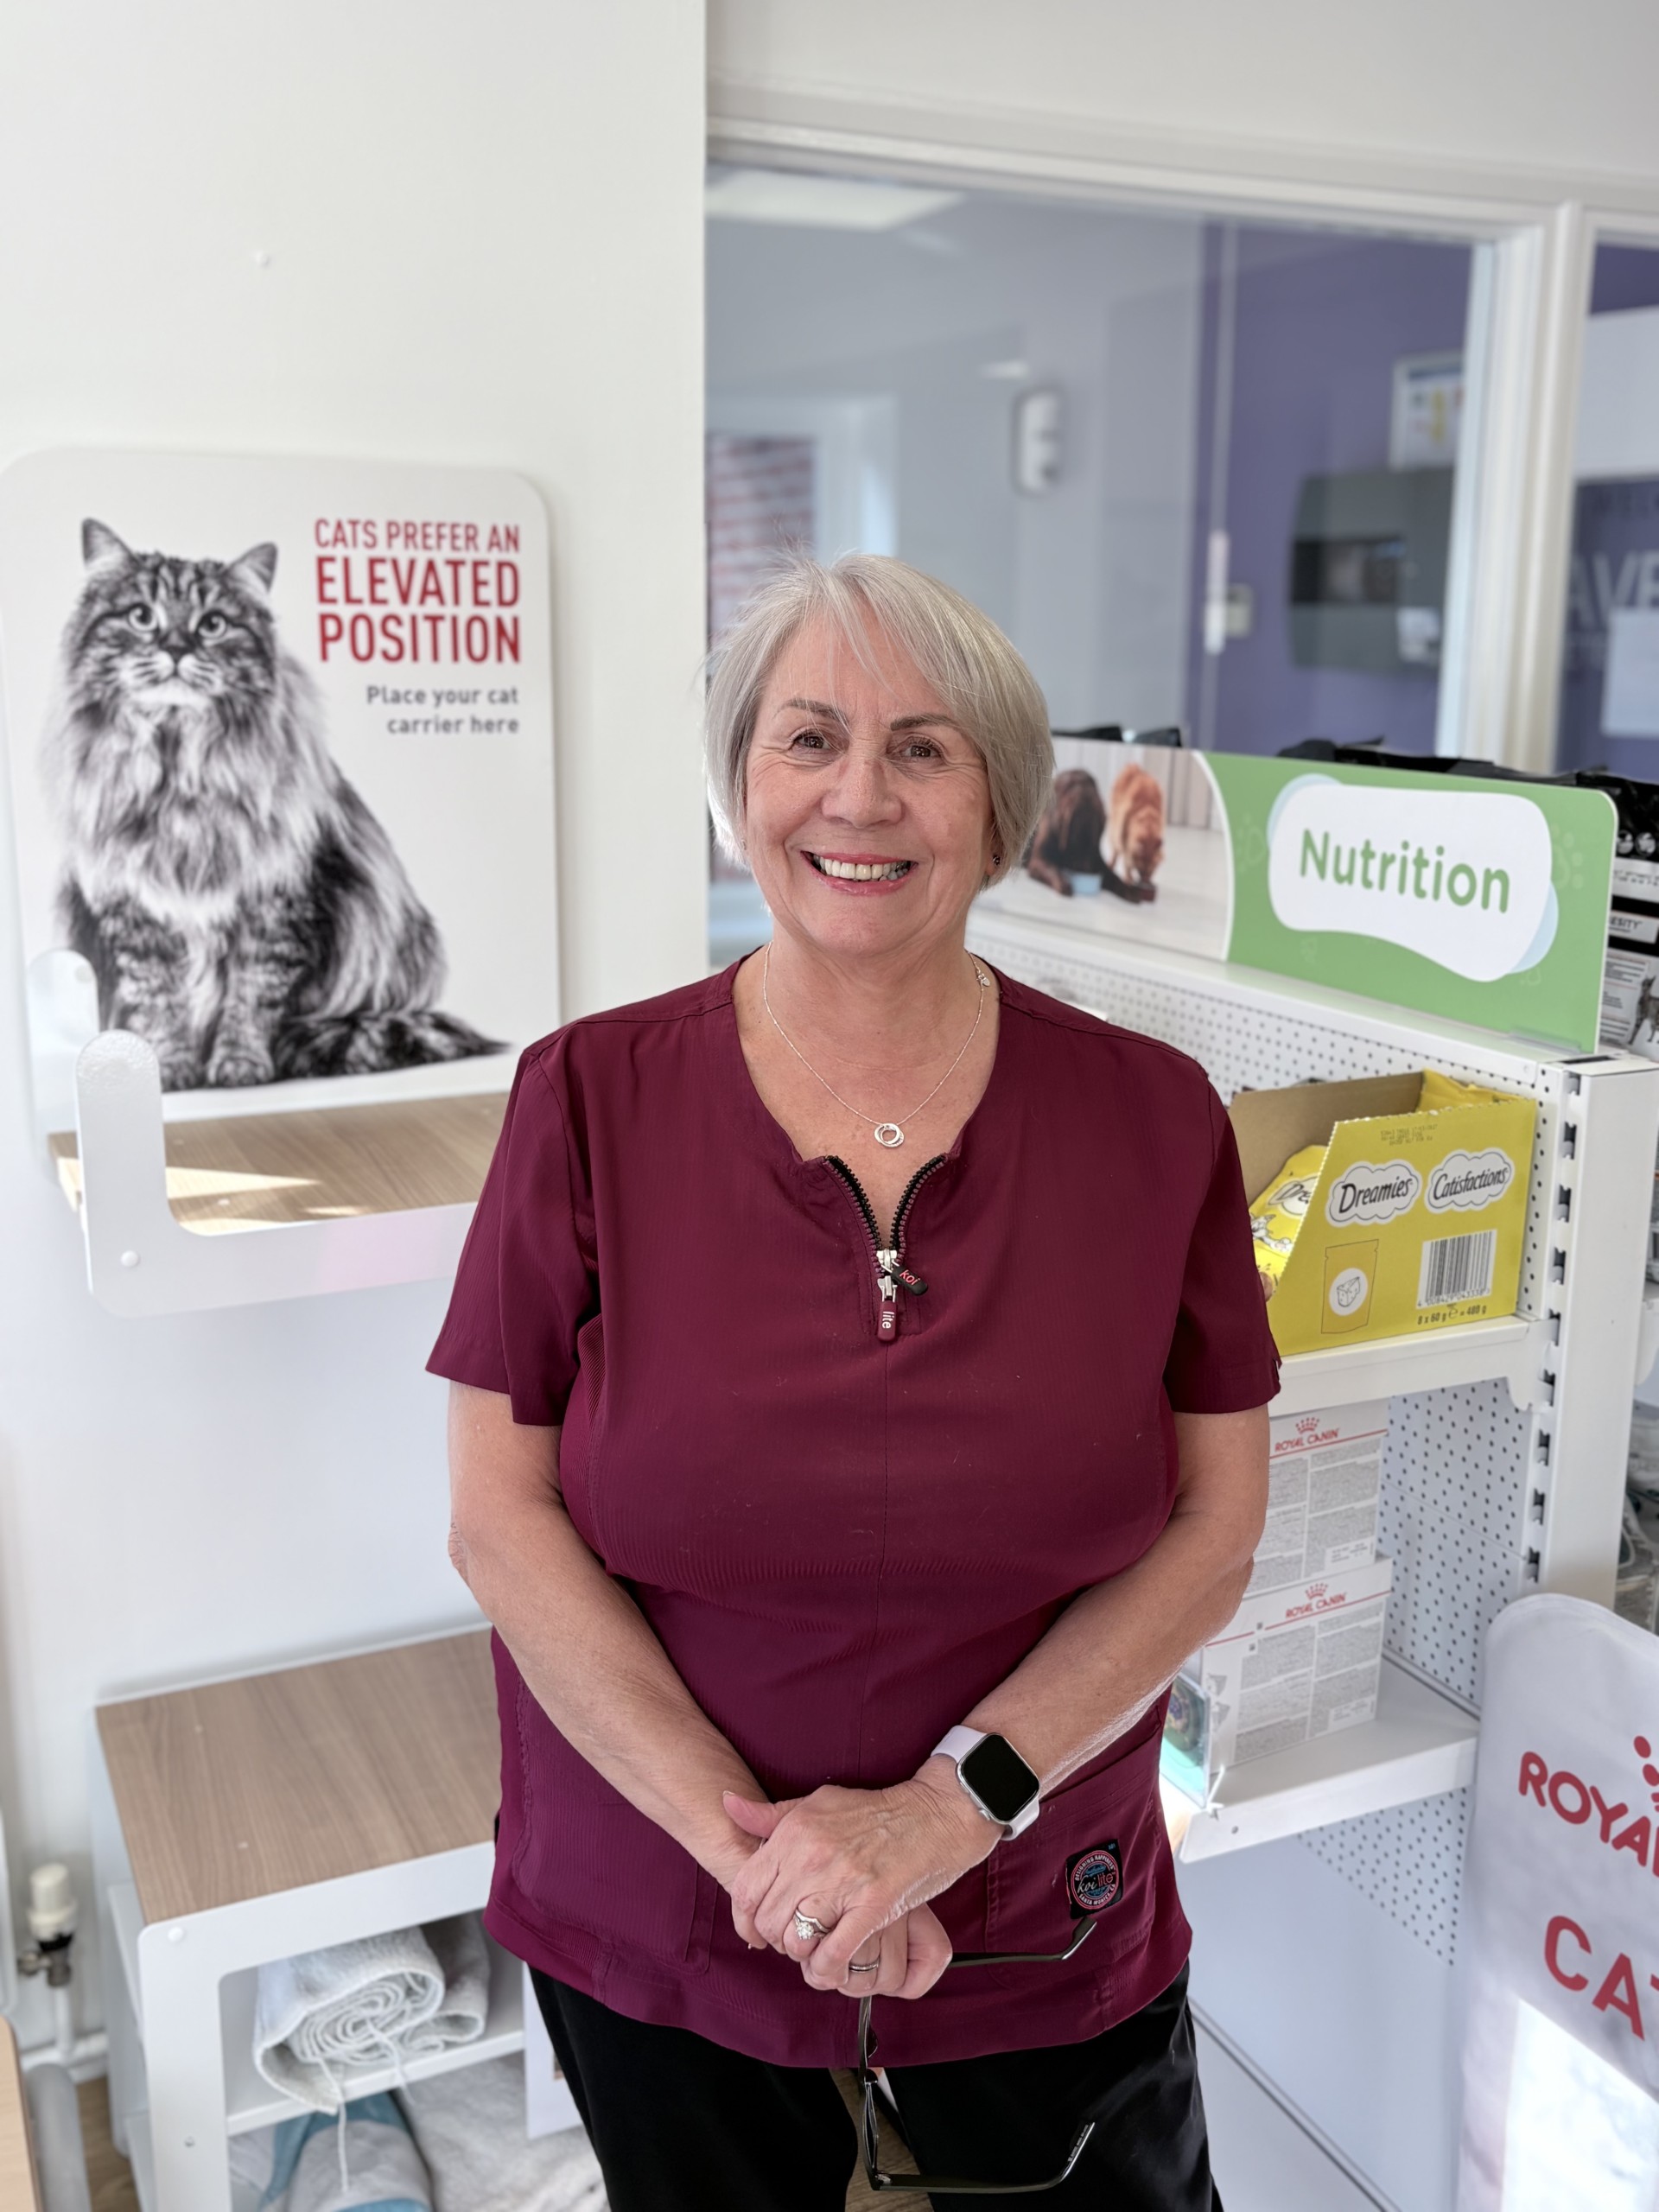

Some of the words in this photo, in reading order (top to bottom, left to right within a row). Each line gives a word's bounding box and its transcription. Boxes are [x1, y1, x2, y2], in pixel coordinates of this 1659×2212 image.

[315, 518, 378, 549] CATS
[387, 520, 480, 552] PREFER
[487, 524, 520, 554] AN
[316, 556, 520, 607] ELEVATED
[319, 613, 521, 664] POSITION
[366, 685, 427, 704] Place
[432, 689, 480, 708] your
[487, 687, 518, 704] cat
[387, 715, 463, 734] carrier
[470, 715, 518, 734] here
[1300, 828, 1510, 914] Nutrition
[1338, 1176, 1413, 1214] Dreamies
[1433, 1166, 1508, 1200] Catisfactions
[899, 1269, 921, 1286] koi
[882, 1311, 895, 1329] lite
[1417, 1315, 1422, 1325] 8
[1431, 1313, 1440, 1322] 60
[1274, 1437, 1305, 1452] ROYAL
[1307, 1428, 1338, 1445] CANIN
[1285, 1603, 1313, 1618] ROYAL
[1316, 1593, 1345, 1609] CANIN
[1518, 1751, 1659, 1878] ROYA
[1077, 1875, 1097, 1894] koi
[1097, 1872, 1113, 1887] lite
[1544, 1916, 1659, 2041] CA
